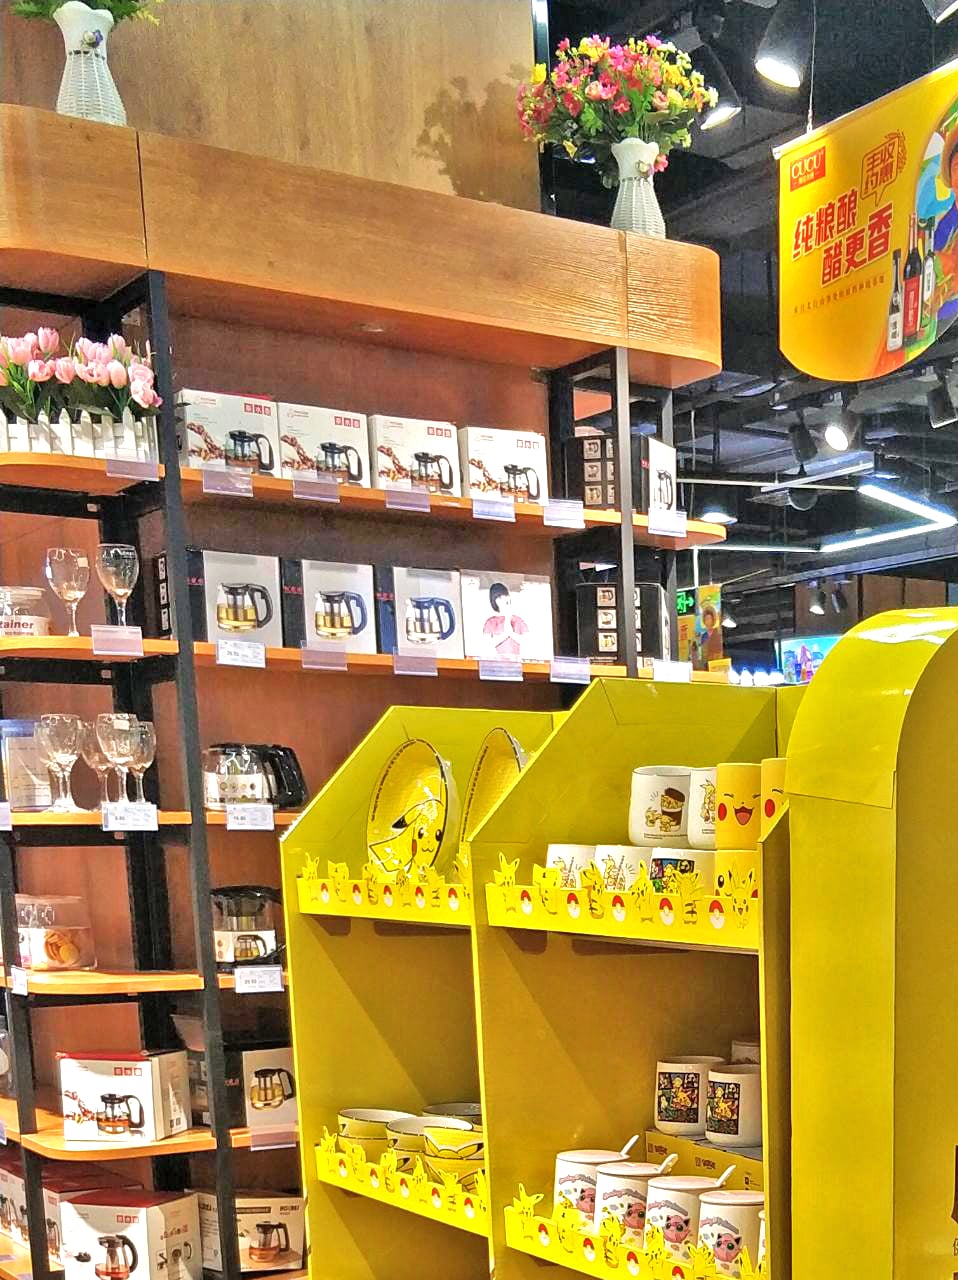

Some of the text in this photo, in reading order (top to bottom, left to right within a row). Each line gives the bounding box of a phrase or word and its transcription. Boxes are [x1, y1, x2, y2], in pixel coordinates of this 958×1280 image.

[792, 187, 858, 261] 纯粮酿
[821, 202, 893, 287] 醋更香
